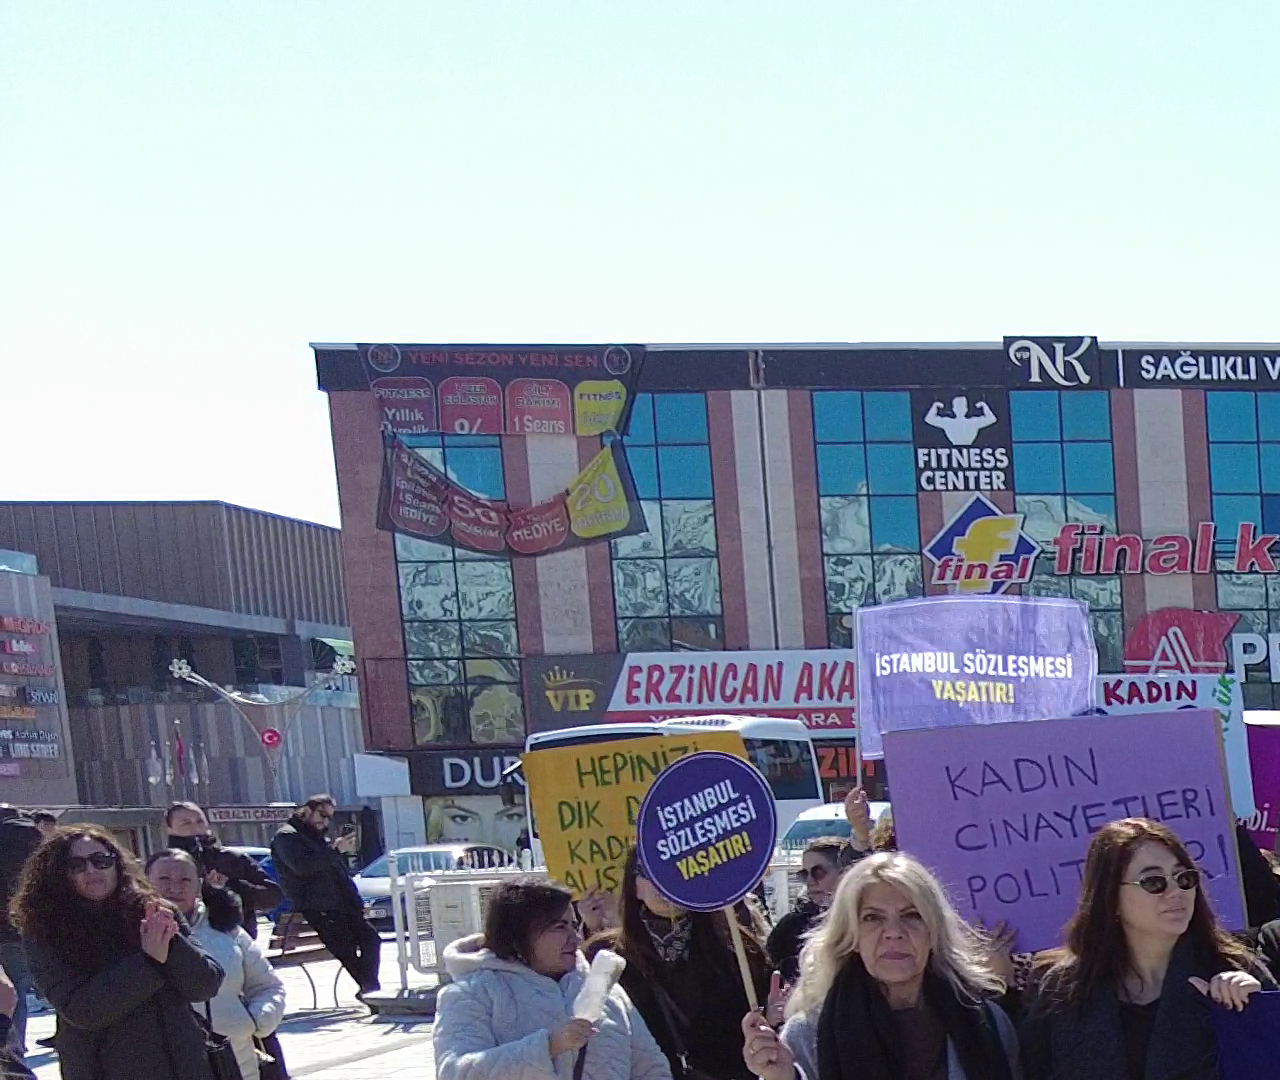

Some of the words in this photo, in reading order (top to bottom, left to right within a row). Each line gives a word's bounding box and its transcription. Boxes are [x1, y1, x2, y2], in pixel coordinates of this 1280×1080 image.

[1140, 351, 1256, 381] SAĞLIKLI
[917, 448, 1010, 470] FITNESS
[920, 469, 1007, 491] CENTER
[1052, 522, 1216, 576] final
[931, 555, 1036, 587] final
[625, 662, 785, 705] ERZİNCAN
[793, 660, 858, 704] AKA
[874, 652, 960, 679] İSTANBUL
[964, 650, 1073, 683] SÖZLEŞMESİ
[544, 688, 597, 713] VIP
[932, 679, 1016, 706] YAŞATIR!
[1102, 679, 1198, 706] KADIN
[443, 757, 525, 790] DUR
[944, 747, 1100, 801] KADIN
[557, 796, 604, 832] DİK
[656, 778, 740, 831] İSTANBUL
[954, 783, 1216, 853] CİNAYETLERİ
[655, 794, 757, 861] SÖZLEŞMESİ
[675, 830, 754, 881] YAŞATIR!
